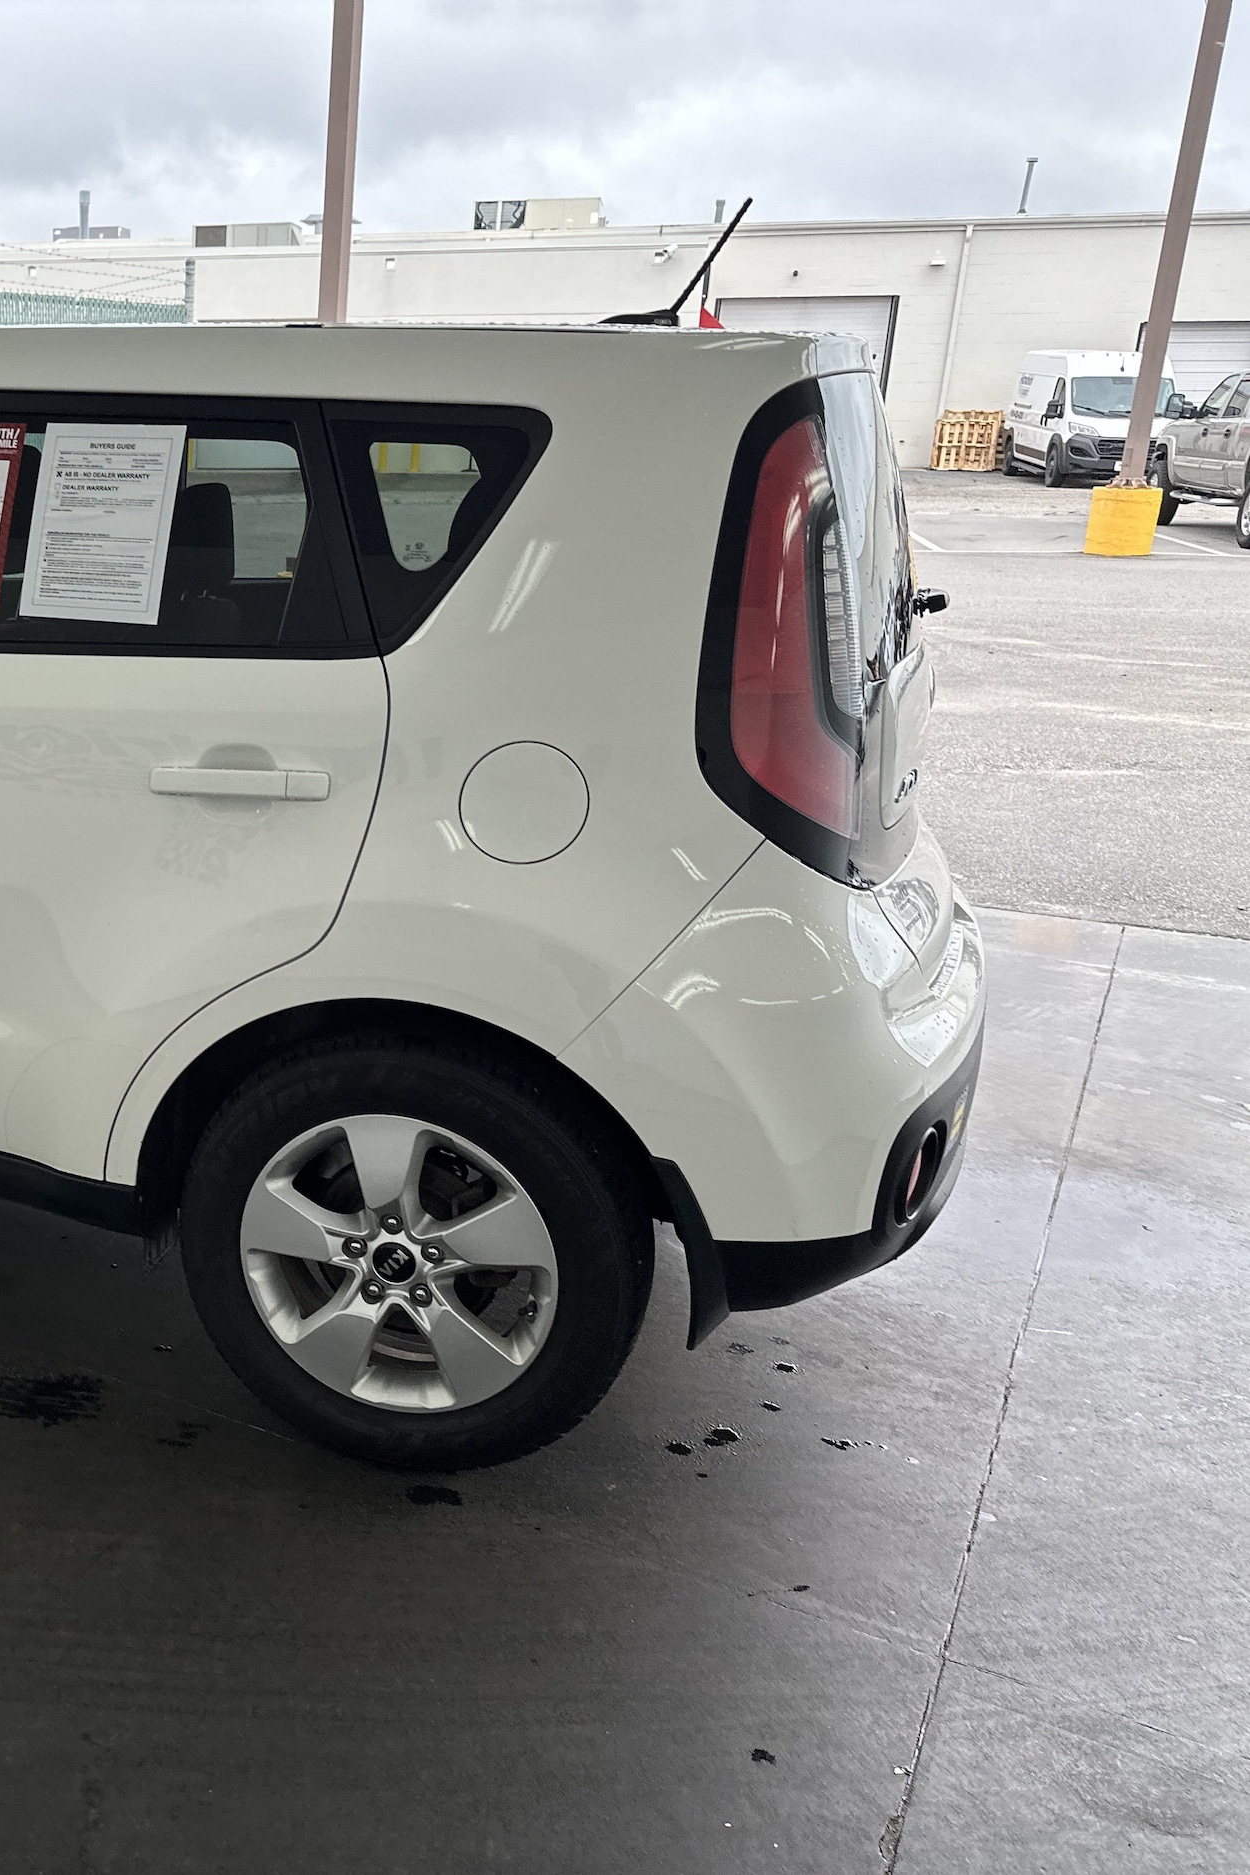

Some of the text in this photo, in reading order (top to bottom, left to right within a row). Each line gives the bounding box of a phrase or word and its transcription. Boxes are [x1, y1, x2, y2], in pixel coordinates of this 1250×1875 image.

[89, 442, 116, 450] BUYERS
[117, 472, 151, 480] WARRANTY
[378, 1248, 410, 1277] KIA
